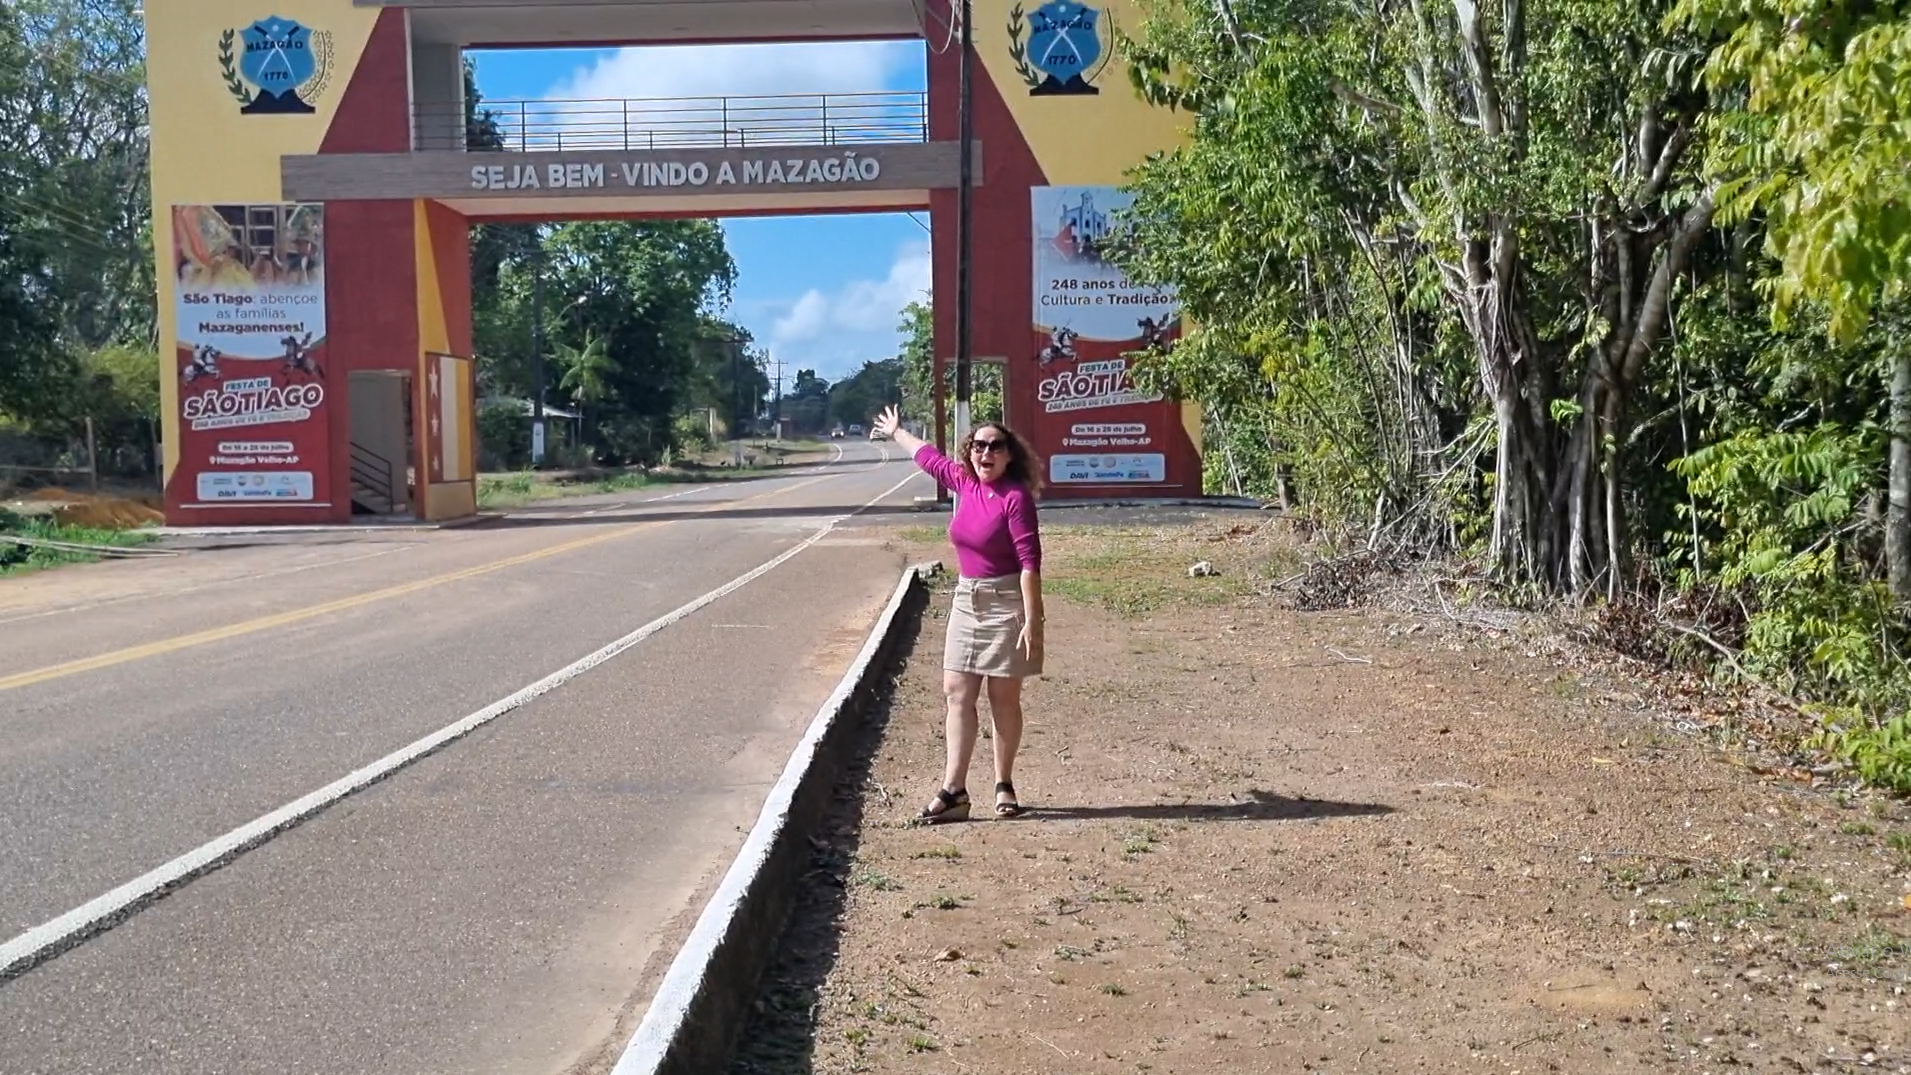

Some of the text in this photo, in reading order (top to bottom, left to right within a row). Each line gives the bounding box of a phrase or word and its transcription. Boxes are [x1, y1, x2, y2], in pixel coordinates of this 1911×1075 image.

[1048, 54, 1077, 65] 1770
[264, 71, 289, 81] 1770
[471, 165, 540, 190] SEJA
[548, 163, 604, 188] BEM
[622, 161, 709, 187] VINDO
[716, 160, 736, 185] A
[742, 151, 880, 185] MAZAGÃO
[1051, 279, 1078, 290] 248
[1082, 281, 1115, 290] anos
[183, 293, 209, 304] São
[260, 294, 318, 306] abençoe
[1041, 294, 1090, 306] Cultura
[1095, 297, 1103, 305] e
[216, 308, 286, 319] as famílias
[199, 322, 304, 335] Mazaganenses!
[1080, 361, 1123, 373] FESTA DE
[225, 378, 269, 391] FESTA DE
[1069, 472, 1089, 480] DAVI
